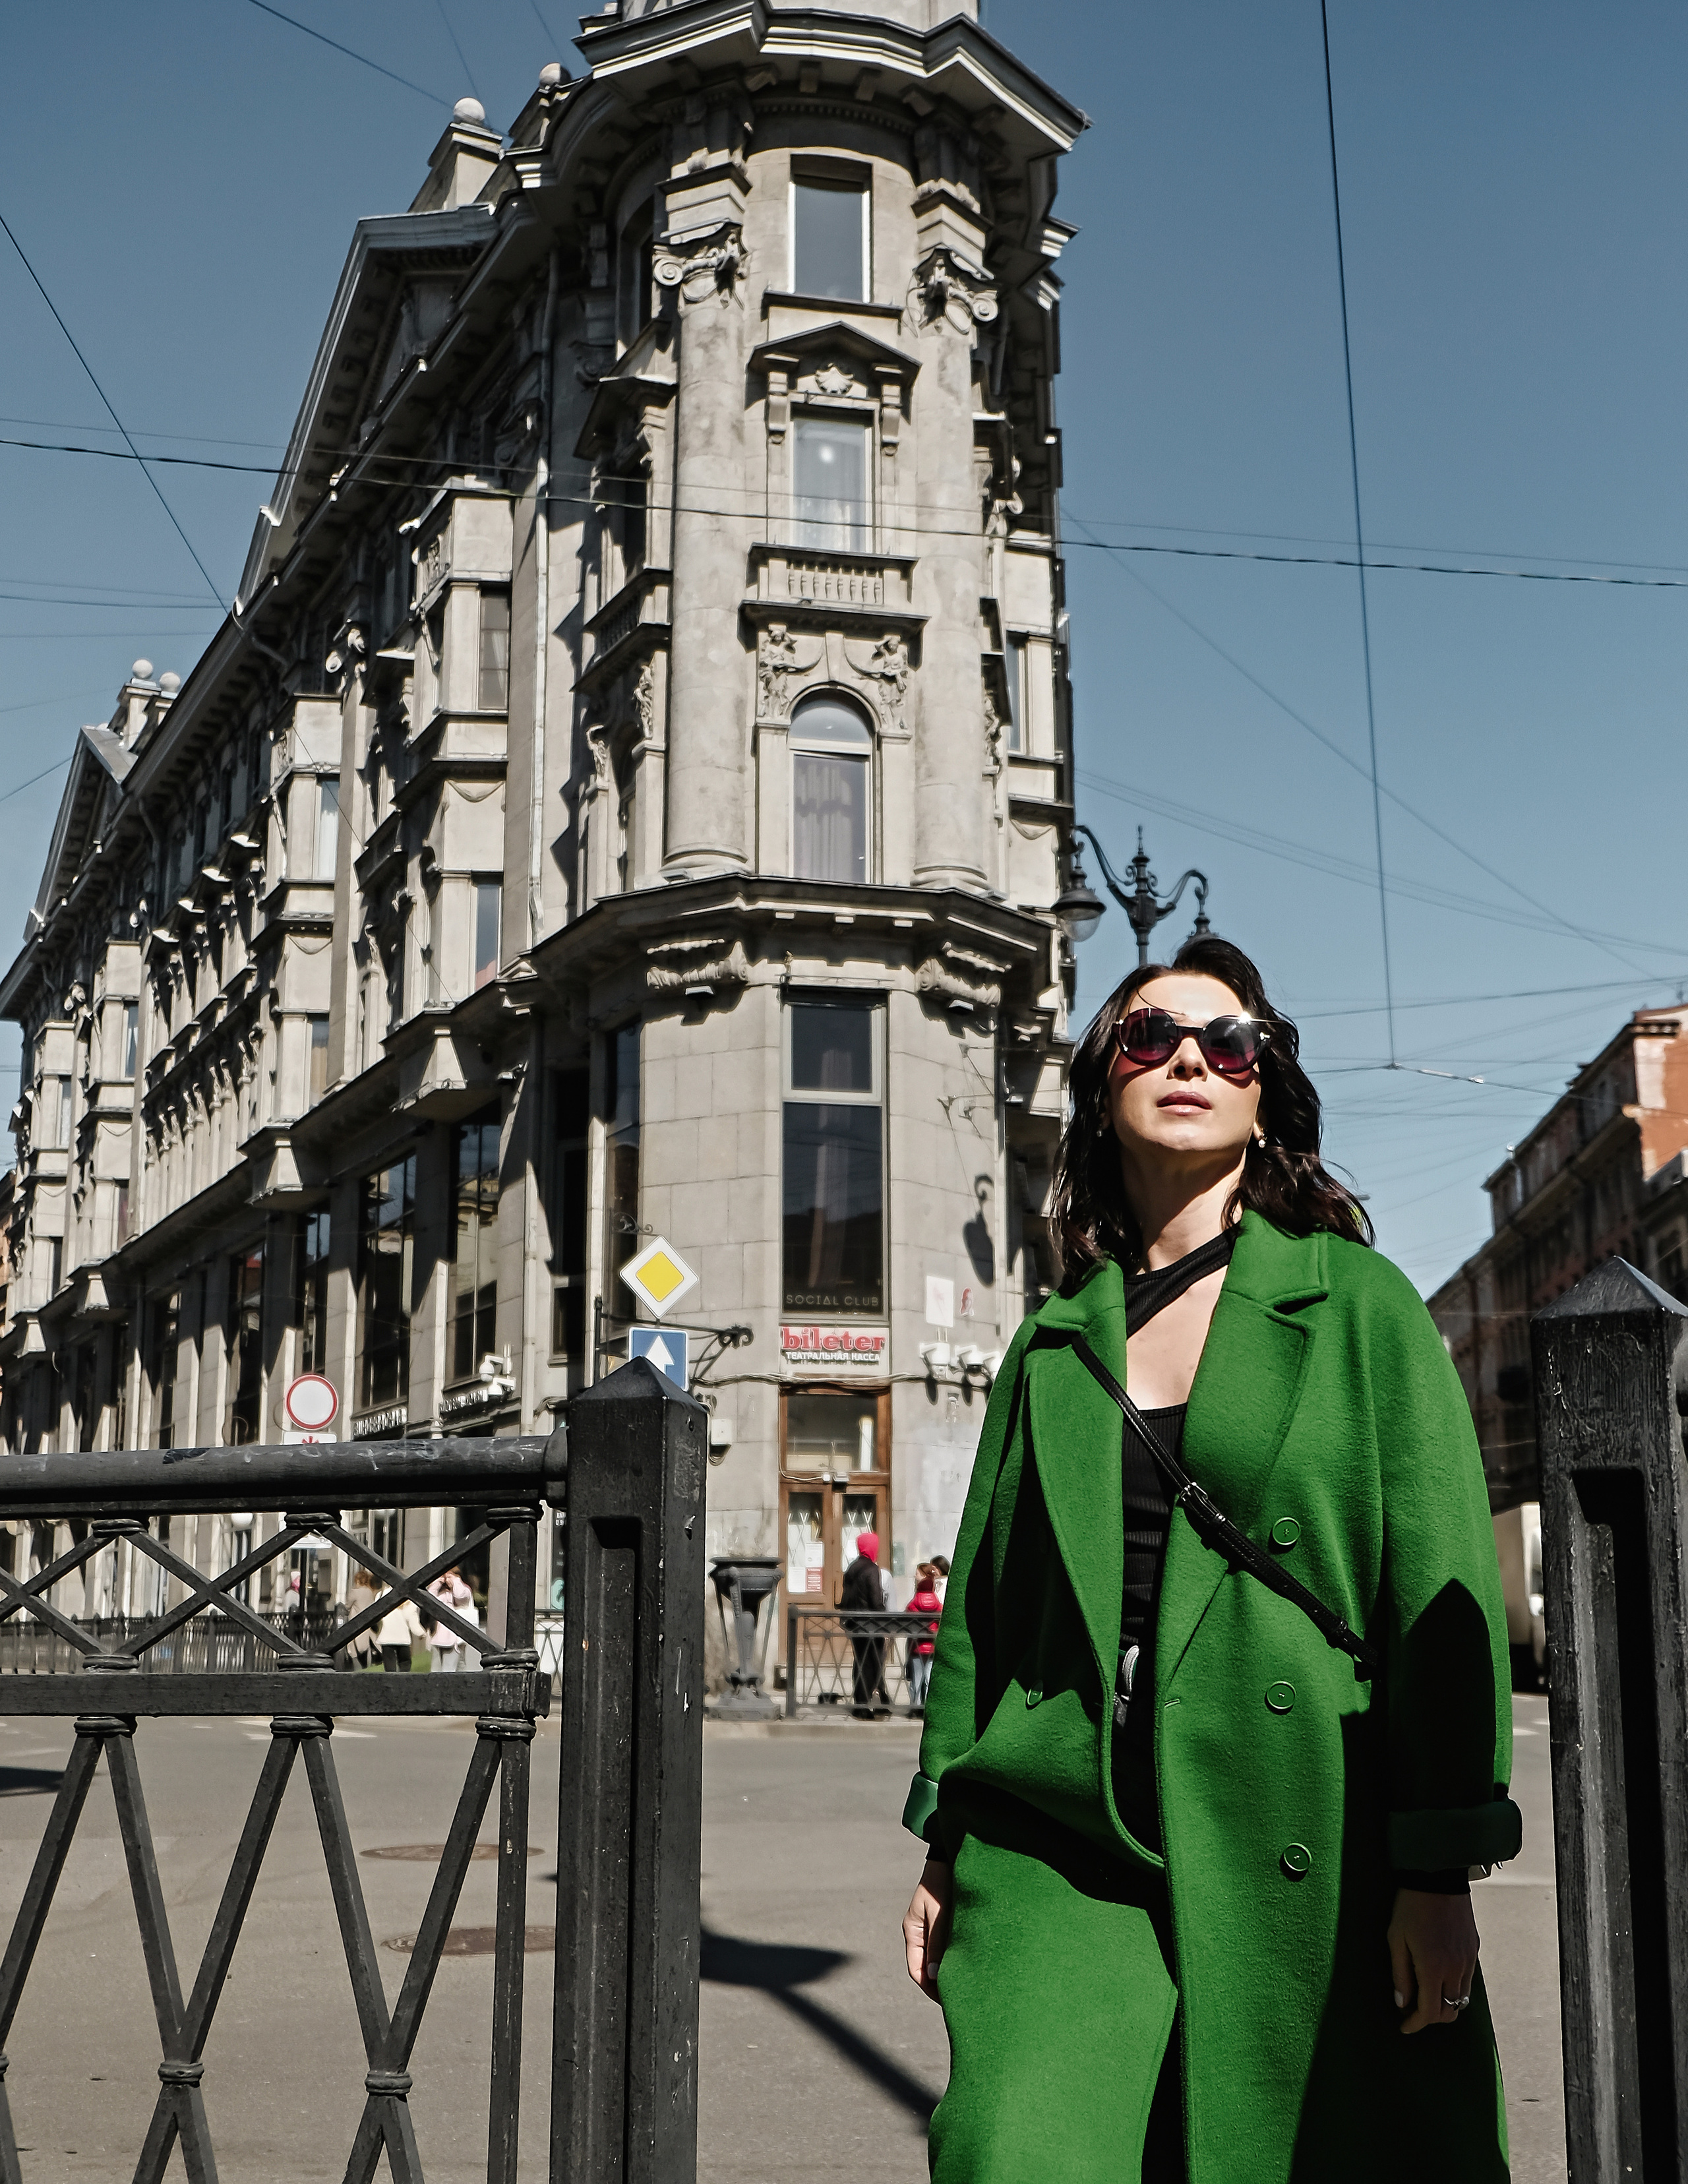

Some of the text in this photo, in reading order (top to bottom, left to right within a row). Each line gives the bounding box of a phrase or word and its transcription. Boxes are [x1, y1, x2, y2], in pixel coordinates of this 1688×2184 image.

[786, 1294, 878, 1306] SOCIAL CLUB
[782, 1327, 885, 1351] bileter
[785, 1352, 880, 1362] ТЕАТРАЛЬНАЯ КАССА
